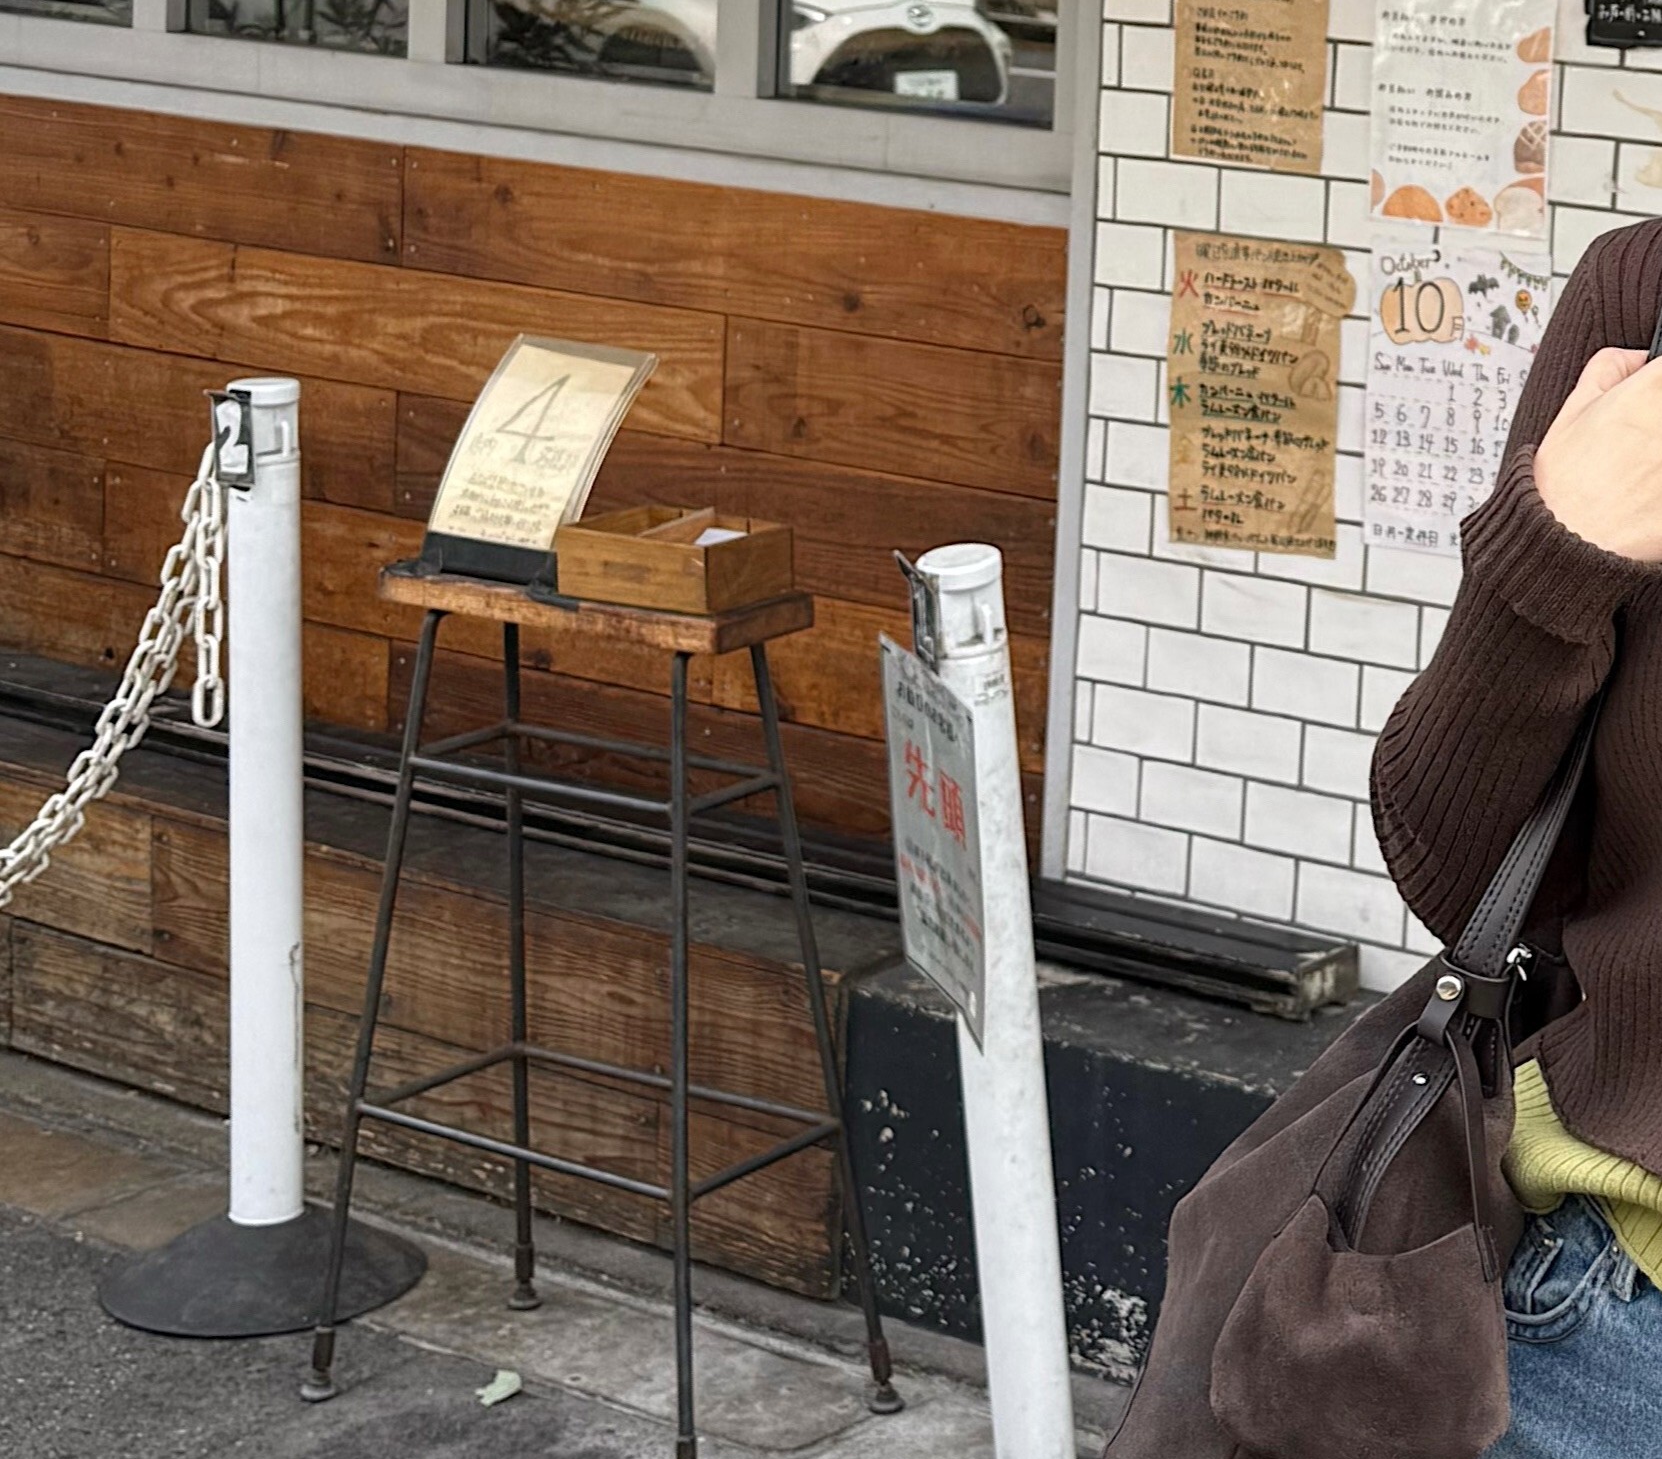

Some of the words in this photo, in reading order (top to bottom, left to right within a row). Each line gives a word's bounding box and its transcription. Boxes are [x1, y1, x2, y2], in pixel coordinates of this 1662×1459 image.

[1380, 251, 1431, 275] October
[1179, 268, 1200, 299] 火
[1172, 328, 1194, 356] 水
[1169, 376, 1192, 409] 木
[1448, 384, 1455, 402] 1
[1472, 388, 1484, 408] 2
[1498, 390, 1508, 410] 3
[494, 374, 575, 464] 4
[1374, 402, 1385, 419] 5
[1396, 404, 1407, 423] 6
[1420, 405, 1431, 429] 7
[1446, 407, 1456, 427] 8
[215, 399, 249, 475] 2
[1396, 431, 1412, 448] 13
[1418, 434, 1435, 453] 14
[1443, 436, 1459, 454] 15
[1469, 438, 1485, 456] 16
[1371, 458, 1386, 480] 19
[1393, 461, 1409, 478] 20
[1418, 462, 1433, 480] 21
[1173, 488, 1198, 512] 土
[1370, 484, 1387, 503] 26
[1392, 486, 1410, 505] 27
[1417, 489, 1433, 509] 28
[904, 738, 967, 851] 先頭
